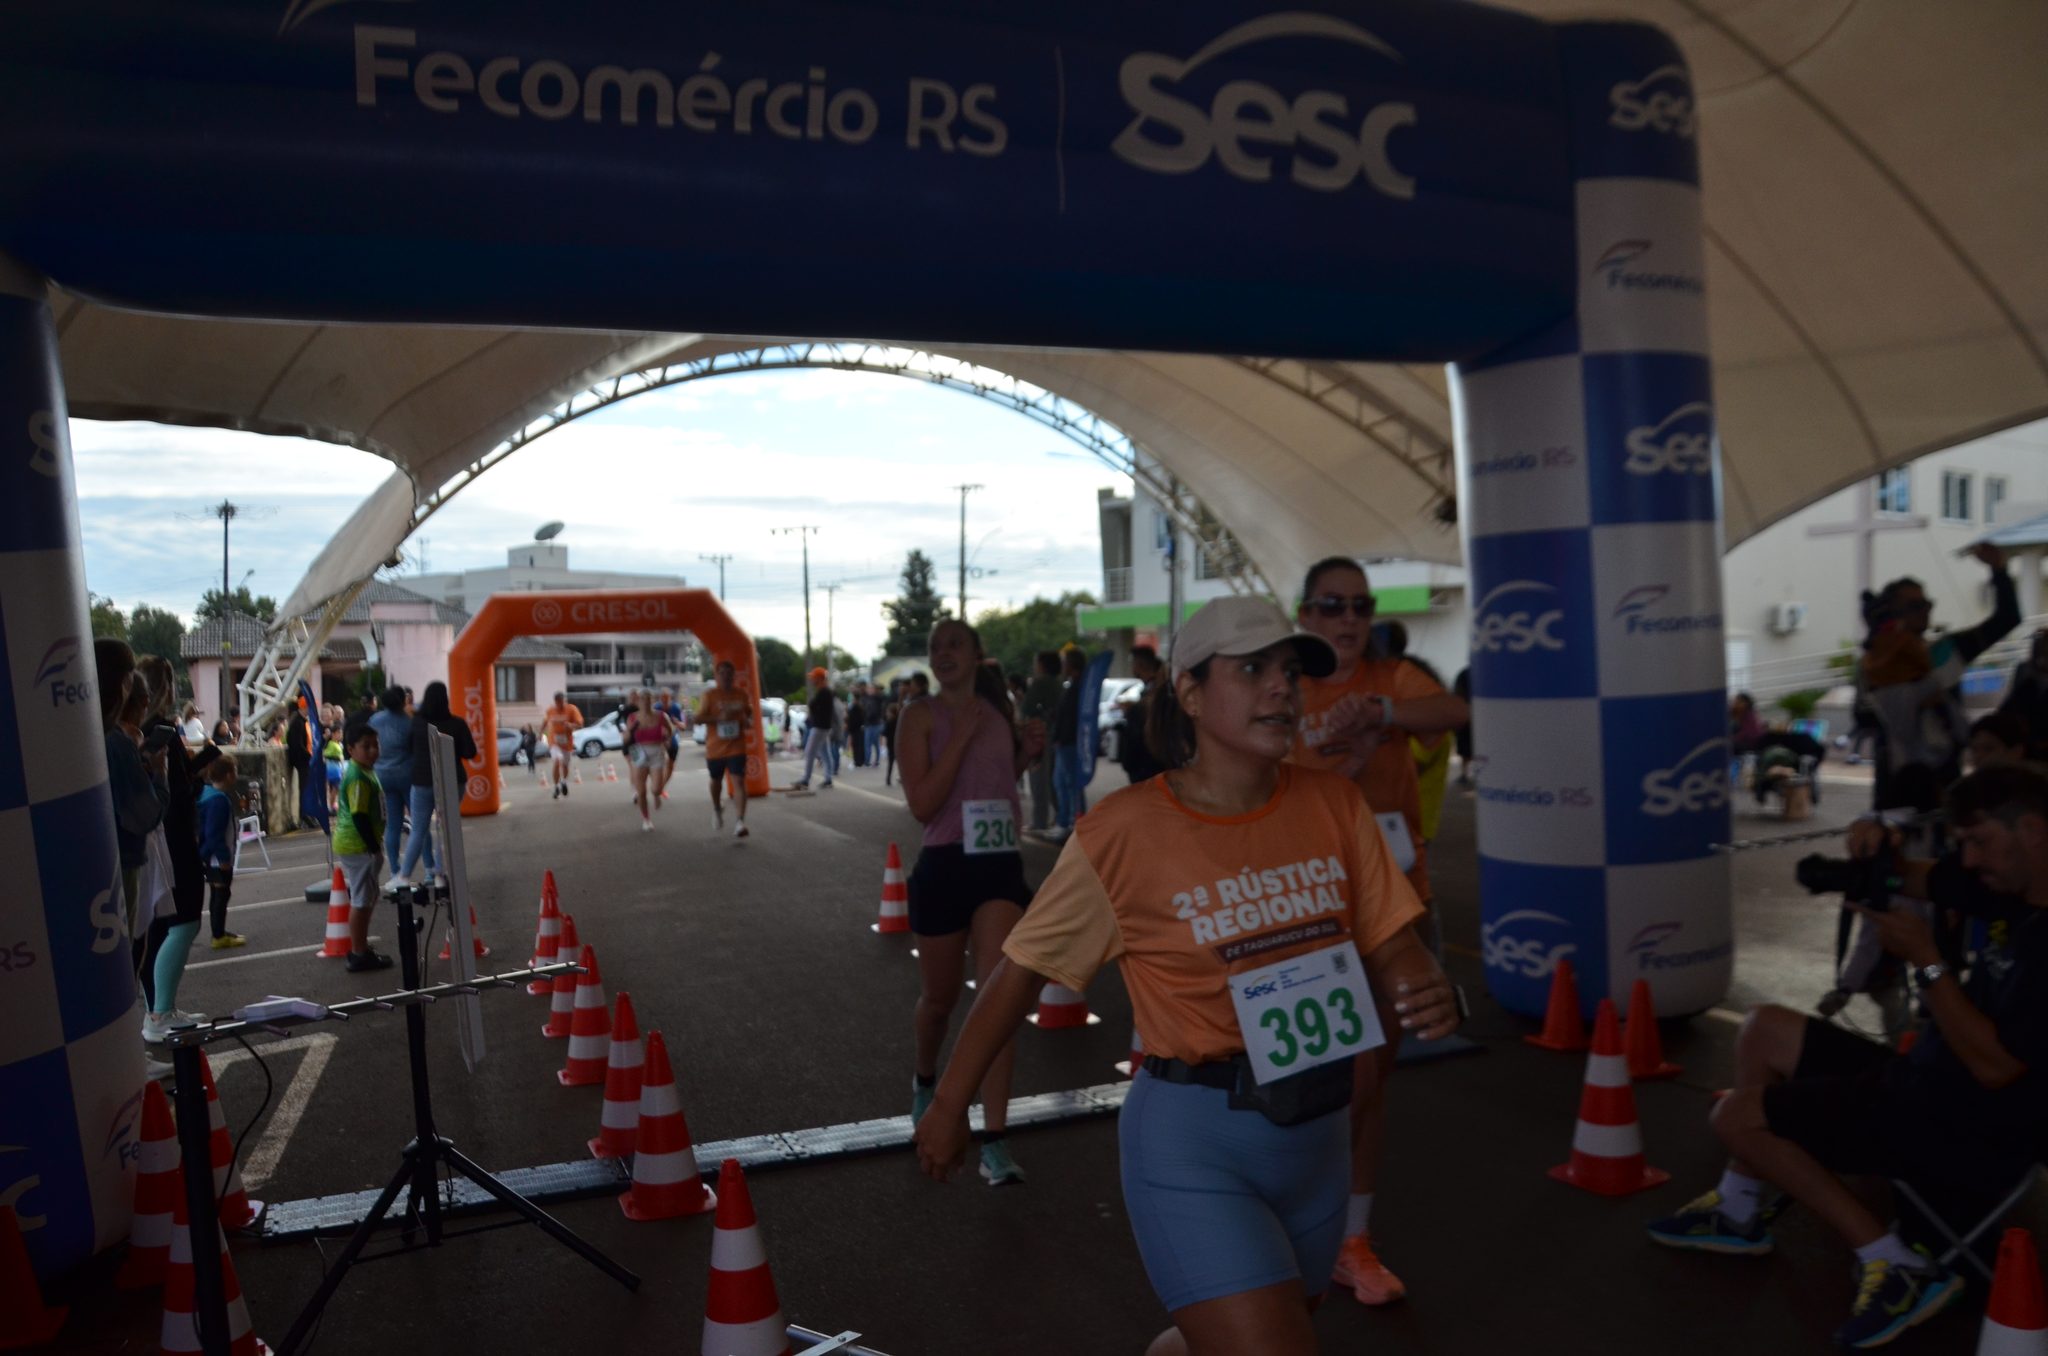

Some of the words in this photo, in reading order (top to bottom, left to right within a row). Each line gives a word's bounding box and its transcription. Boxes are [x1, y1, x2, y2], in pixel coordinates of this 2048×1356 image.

[353, 24, 879, 145] Fecomércio
[906, 76, 1009, 158] RS
[1110, 48, 1417, 200] Sesc
[571, 599, 678, 624] CRESOL
[1559, 786, 1593, 808] RS
[973, 818, 1016, 848] 230
[1215, 855, 1348, 906] RÚSTICA
[1190, 884, 1347, 945] REGIONAL
[1243, 979, 1278, 1000] Sesc
[1259, 987, 1363, 1067] 393
